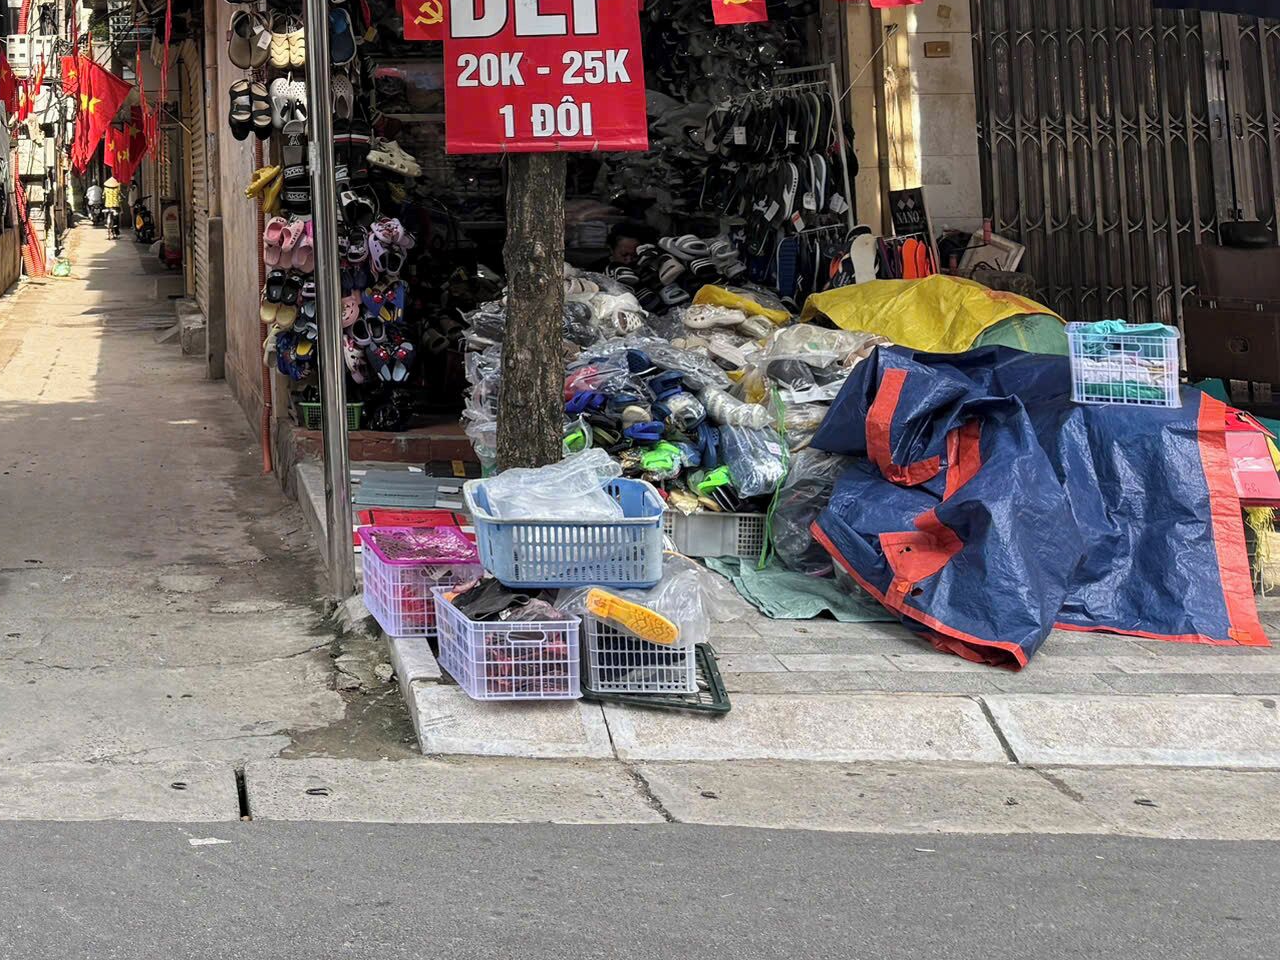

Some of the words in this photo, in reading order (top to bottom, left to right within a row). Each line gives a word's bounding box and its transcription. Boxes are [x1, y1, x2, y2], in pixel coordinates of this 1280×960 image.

[456, 52, 526, 88] 20K
[561, 49, 632, 85] 25K
[498, 104, 515, 138] 1
[530, 96, 593, 137] ĐÔI
